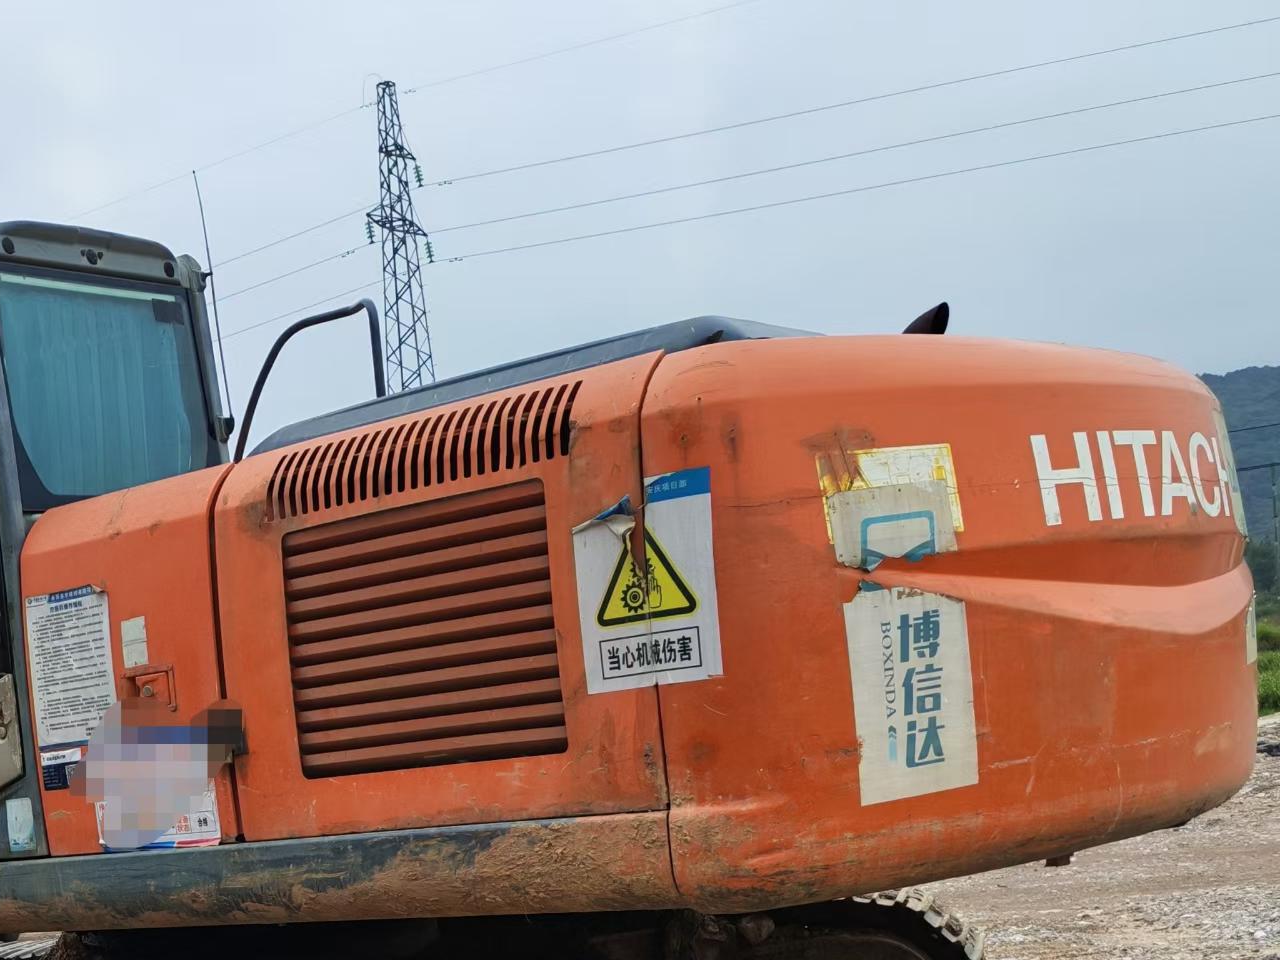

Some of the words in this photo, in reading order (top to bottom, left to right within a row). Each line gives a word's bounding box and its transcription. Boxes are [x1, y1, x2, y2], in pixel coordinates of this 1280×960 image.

[608, 635, 693, 671] 当心机械伤害
[880, 621, 897, 719] BOXINDA
[897, 609, 945, 768] 博信达
